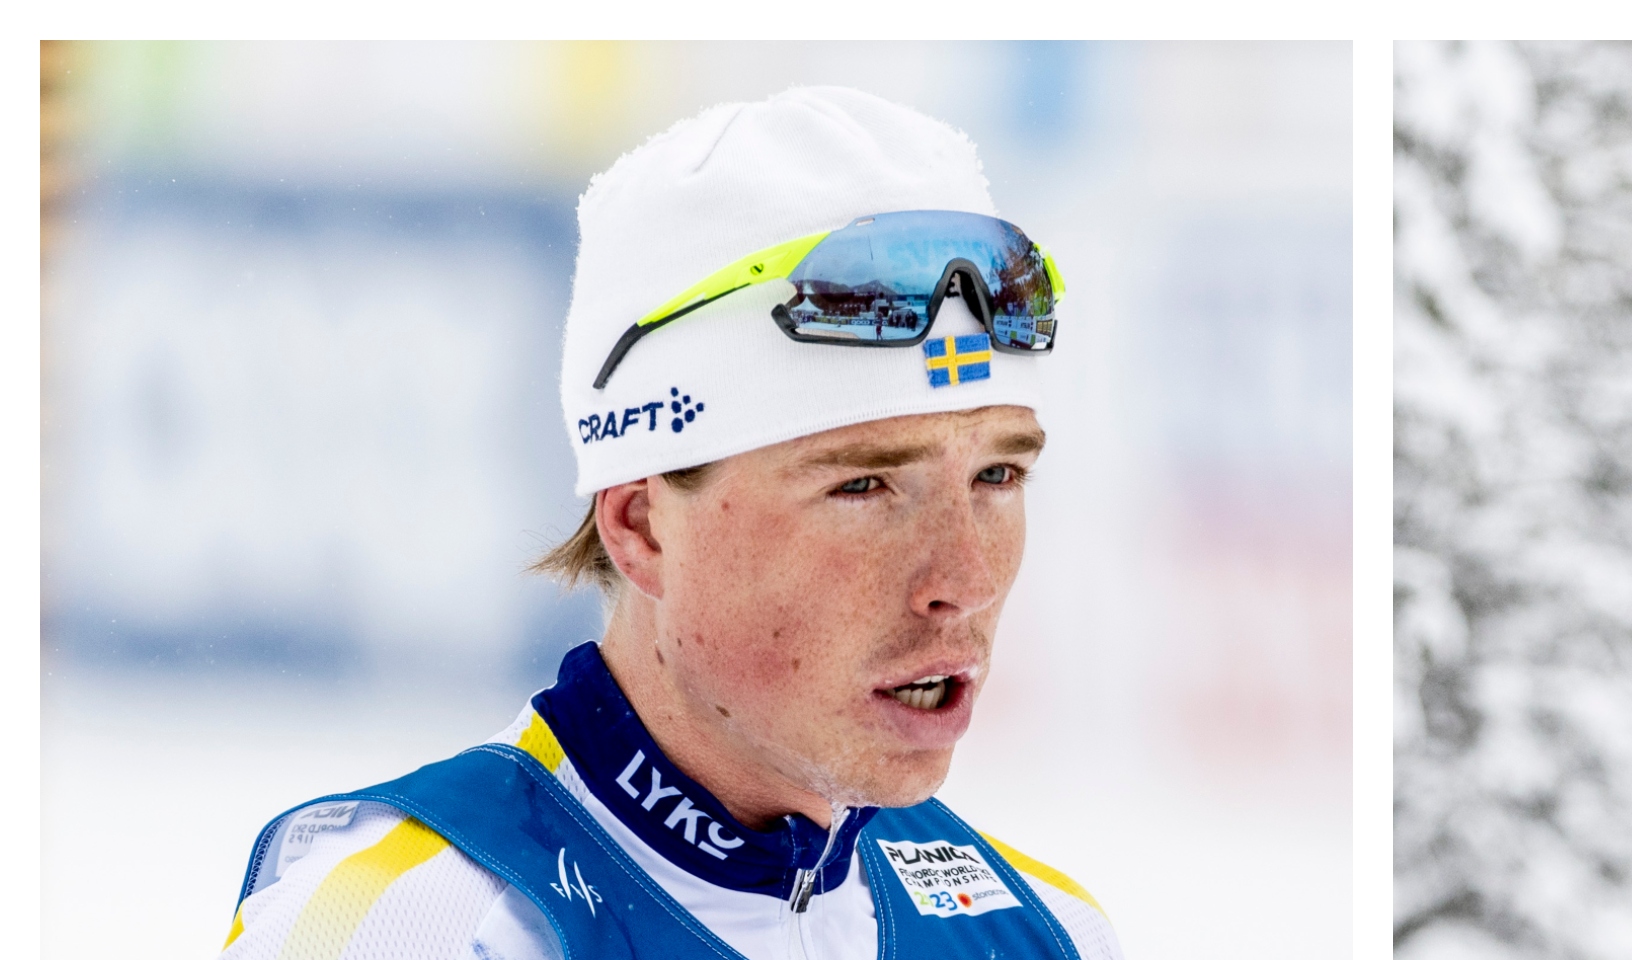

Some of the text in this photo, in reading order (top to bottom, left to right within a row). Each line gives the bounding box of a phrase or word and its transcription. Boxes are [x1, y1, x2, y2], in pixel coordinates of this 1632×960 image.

[578, 401, 664, 444] CRAFT
[615, 749, 745, 861] LYKO
[885, 846, 980, 865] PLANICA
